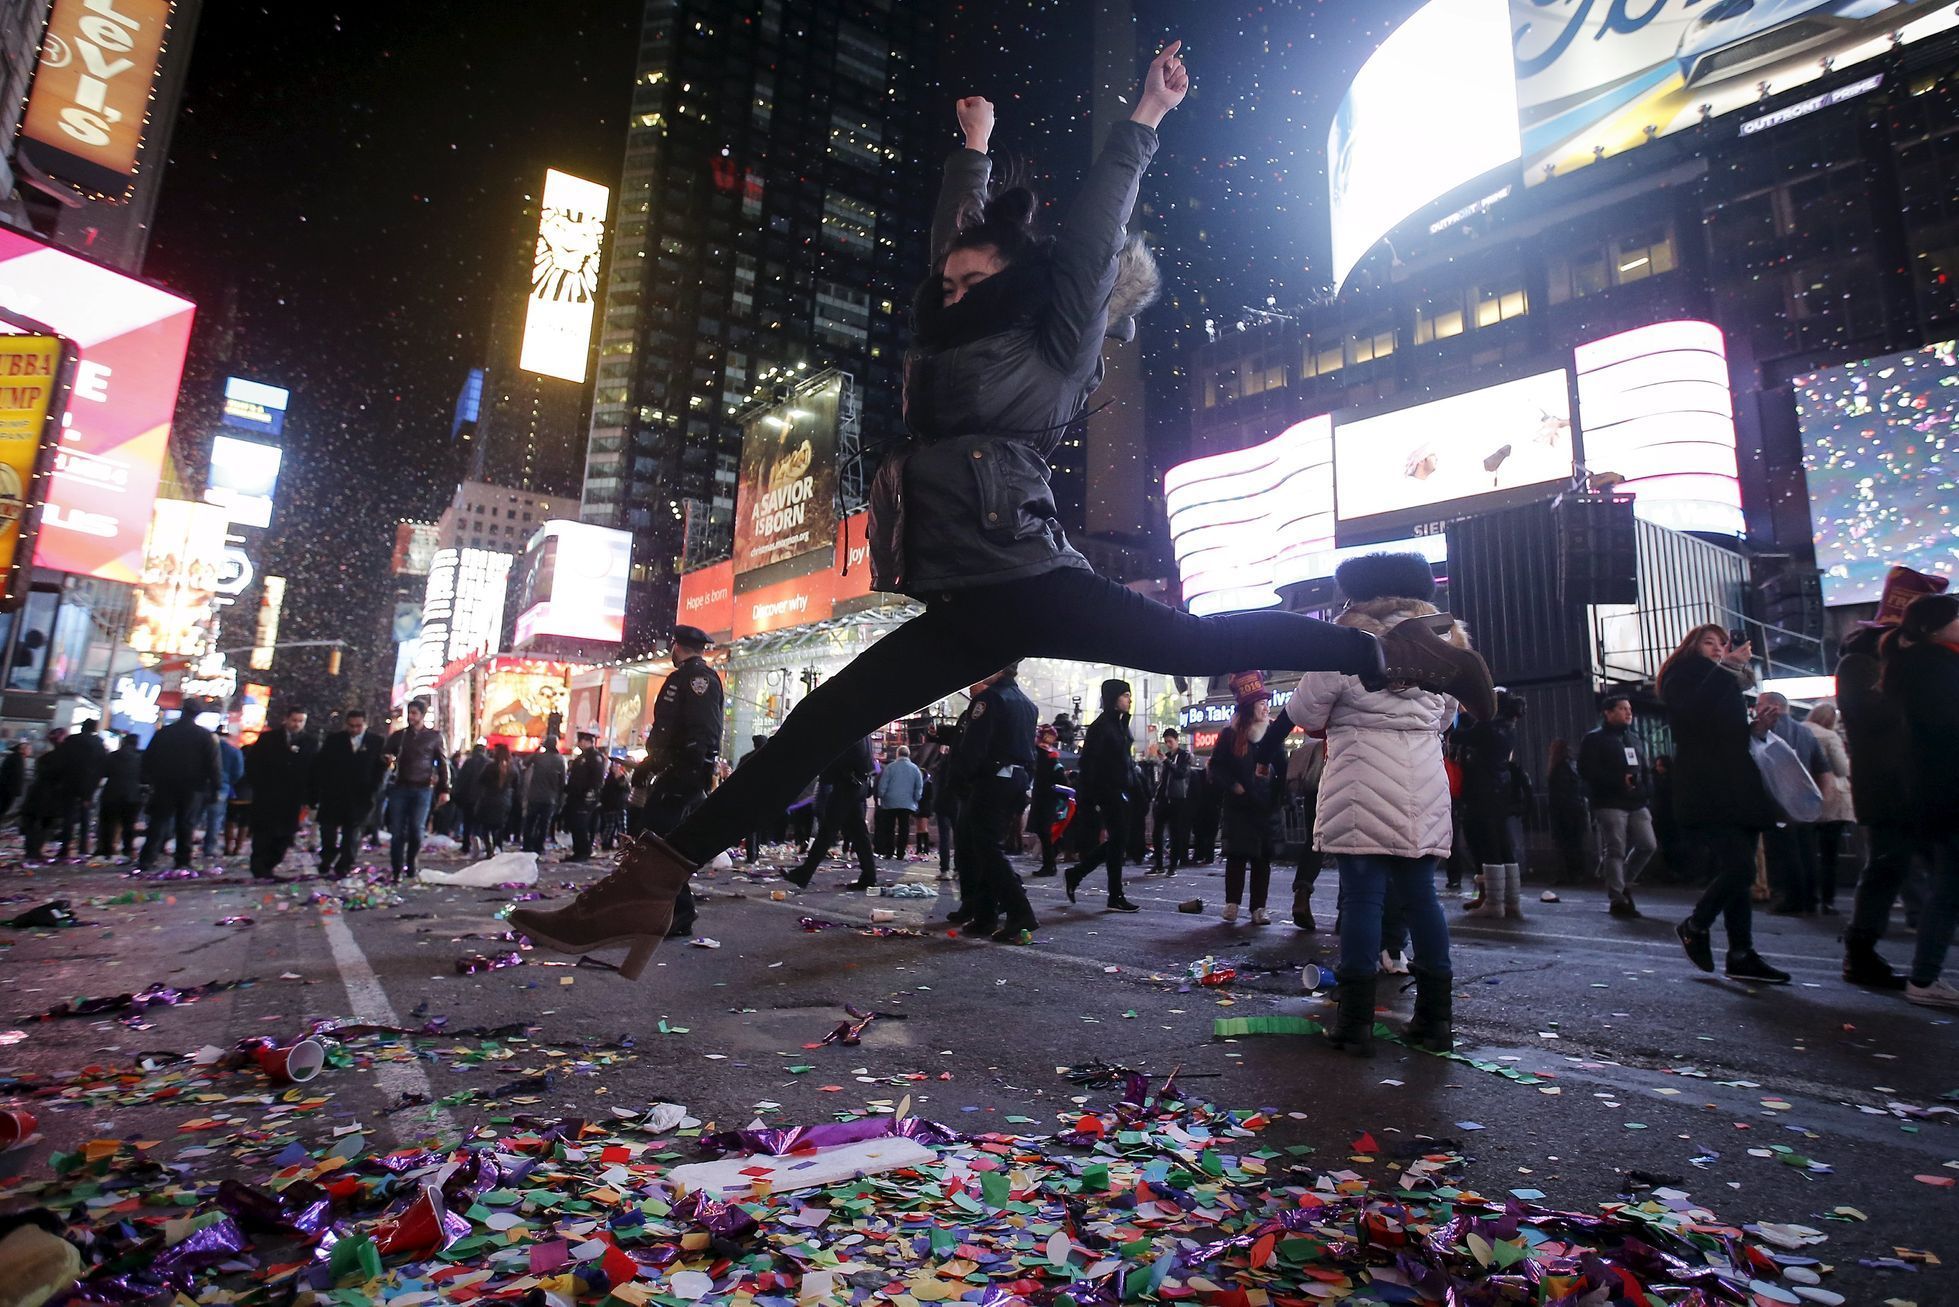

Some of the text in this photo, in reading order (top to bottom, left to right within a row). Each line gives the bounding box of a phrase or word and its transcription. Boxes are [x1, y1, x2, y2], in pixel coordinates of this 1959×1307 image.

[752, 476, 814, 520] A SAVIOR
[765, 502, 805, 537] BORN
[847, 546, 866, 567] Joy
[686, 587, 728, 612] Hope is born
[752, 592, 808, 621] Discover why
[1240, 680, 1262, 696] 2016
[1189, 708, 1204, 724] Be
[1205, 704, 1235, 722] Taki
